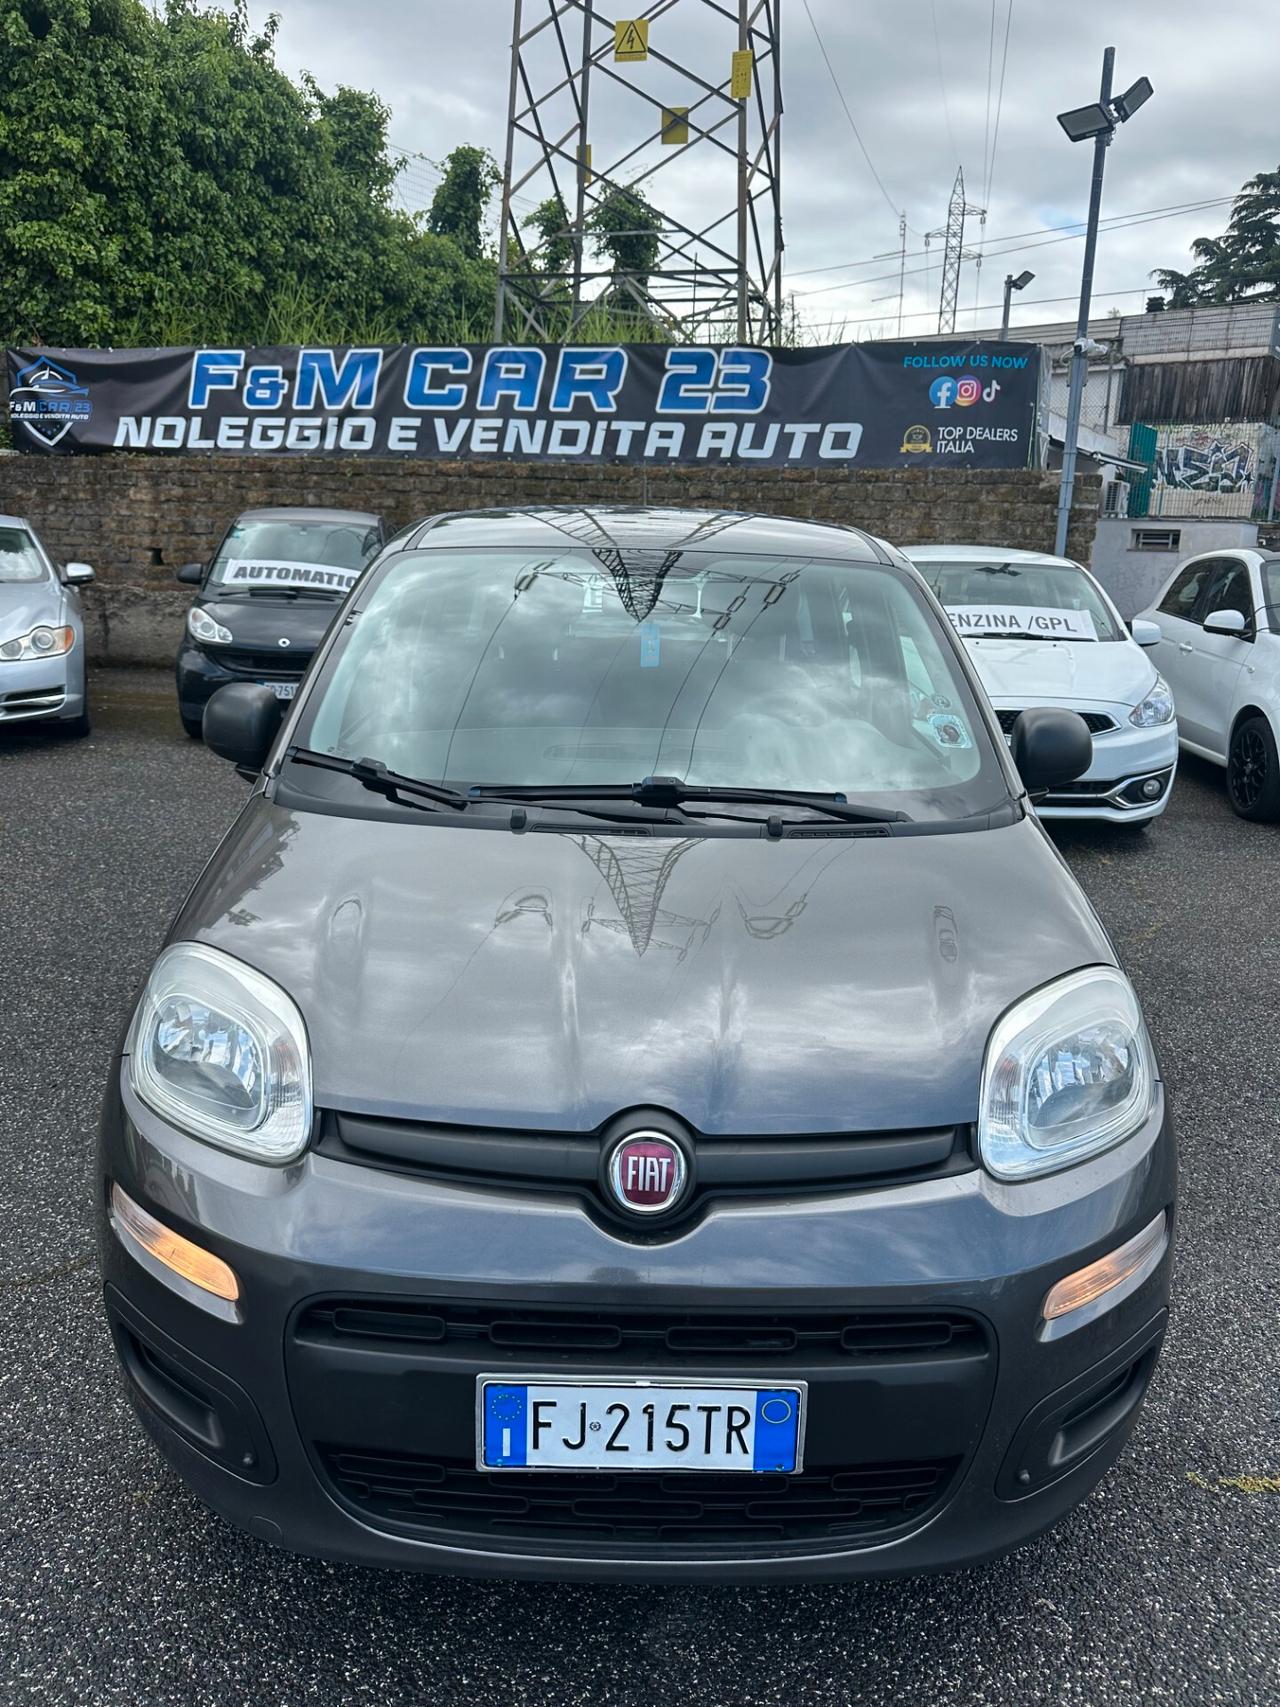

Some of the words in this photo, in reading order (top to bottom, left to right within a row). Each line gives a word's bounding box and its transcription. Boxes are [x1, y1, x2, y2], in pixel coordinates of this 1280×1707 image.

[903, 355, 966, 368] FOLLOW
[970, 355, 988, 367] US
[991, 356, 1028, 369] NOW
[188, 349, 384, 410] F&M
[403, 347, 628, 412] CAR
[655, 347, 773, 415] 23
[113, 416, 376, 450] NOLEGGIO
[387, 417, 422, 451] E
[433, 417, 685, 457] VENDITA
[696, 422, 864, 459] AUTO
[938, 426, 963, 440] TOP
[966, 426, 1018, 442] DEALERS
[936, 440, 975, 454] ITALIA
[948, 613, 1021, 628] ENZINA
[1028, 615, 1078, 632] /GPL
[627, 1156, 672, 1193] FIAT
